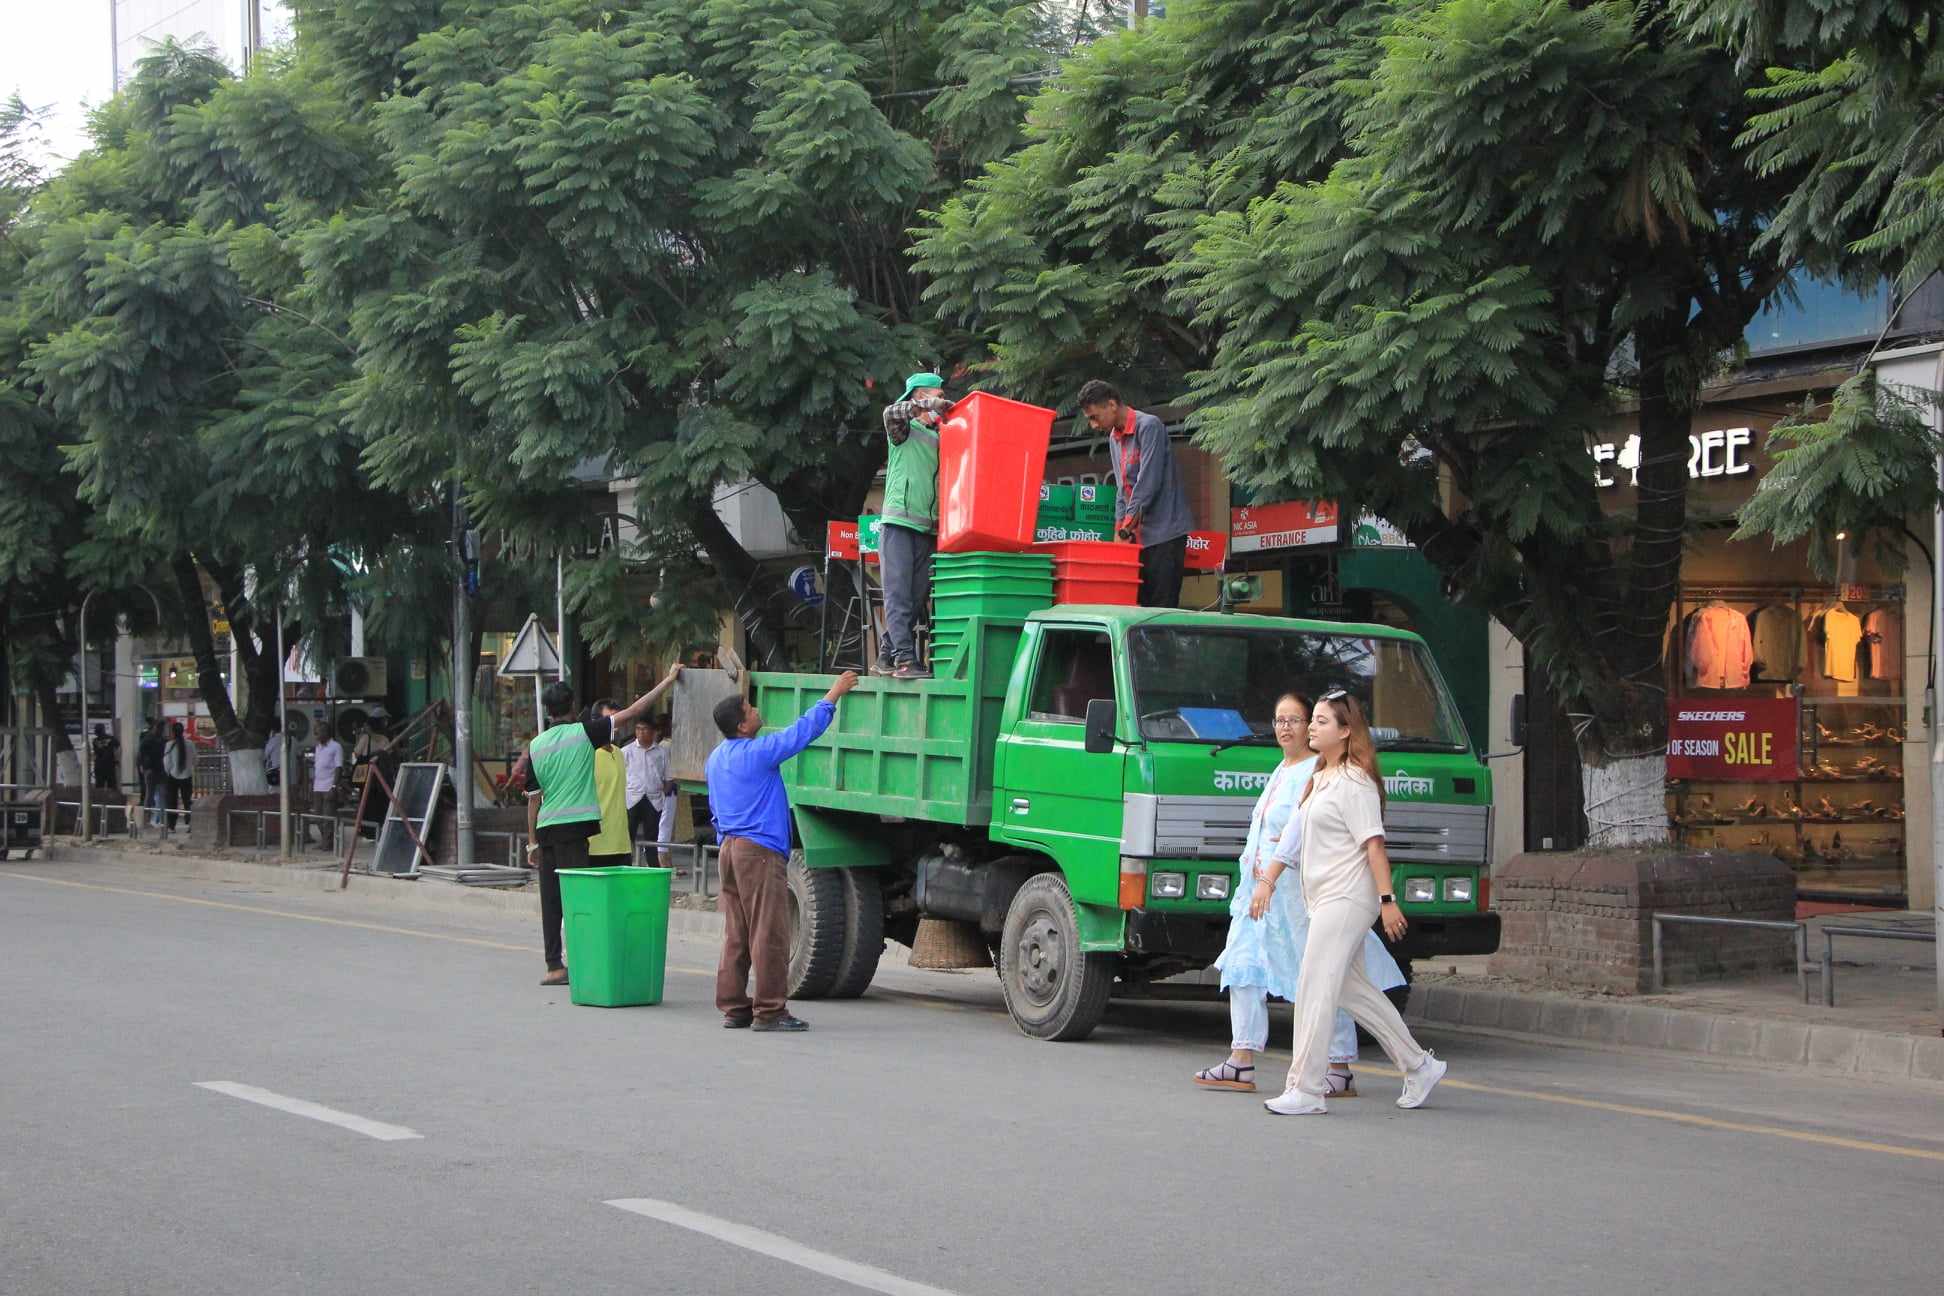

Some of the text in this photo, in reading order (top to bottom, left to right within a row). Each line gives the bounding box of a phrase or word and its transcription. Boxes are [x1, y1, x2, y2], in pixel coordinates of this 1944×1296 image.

[1244, 520, 1258, 530] ASIA
[840, 530, 854, 539] Non
[1260, 531, 1307, 548] ENTRANCE
[1678, 711, 1746, 721] SKECHERS
[1671, 739, 1683, 756] OF
[1684, 739, 1719, 756] SEASON
[1724, 732, 1773, 765] SALE
